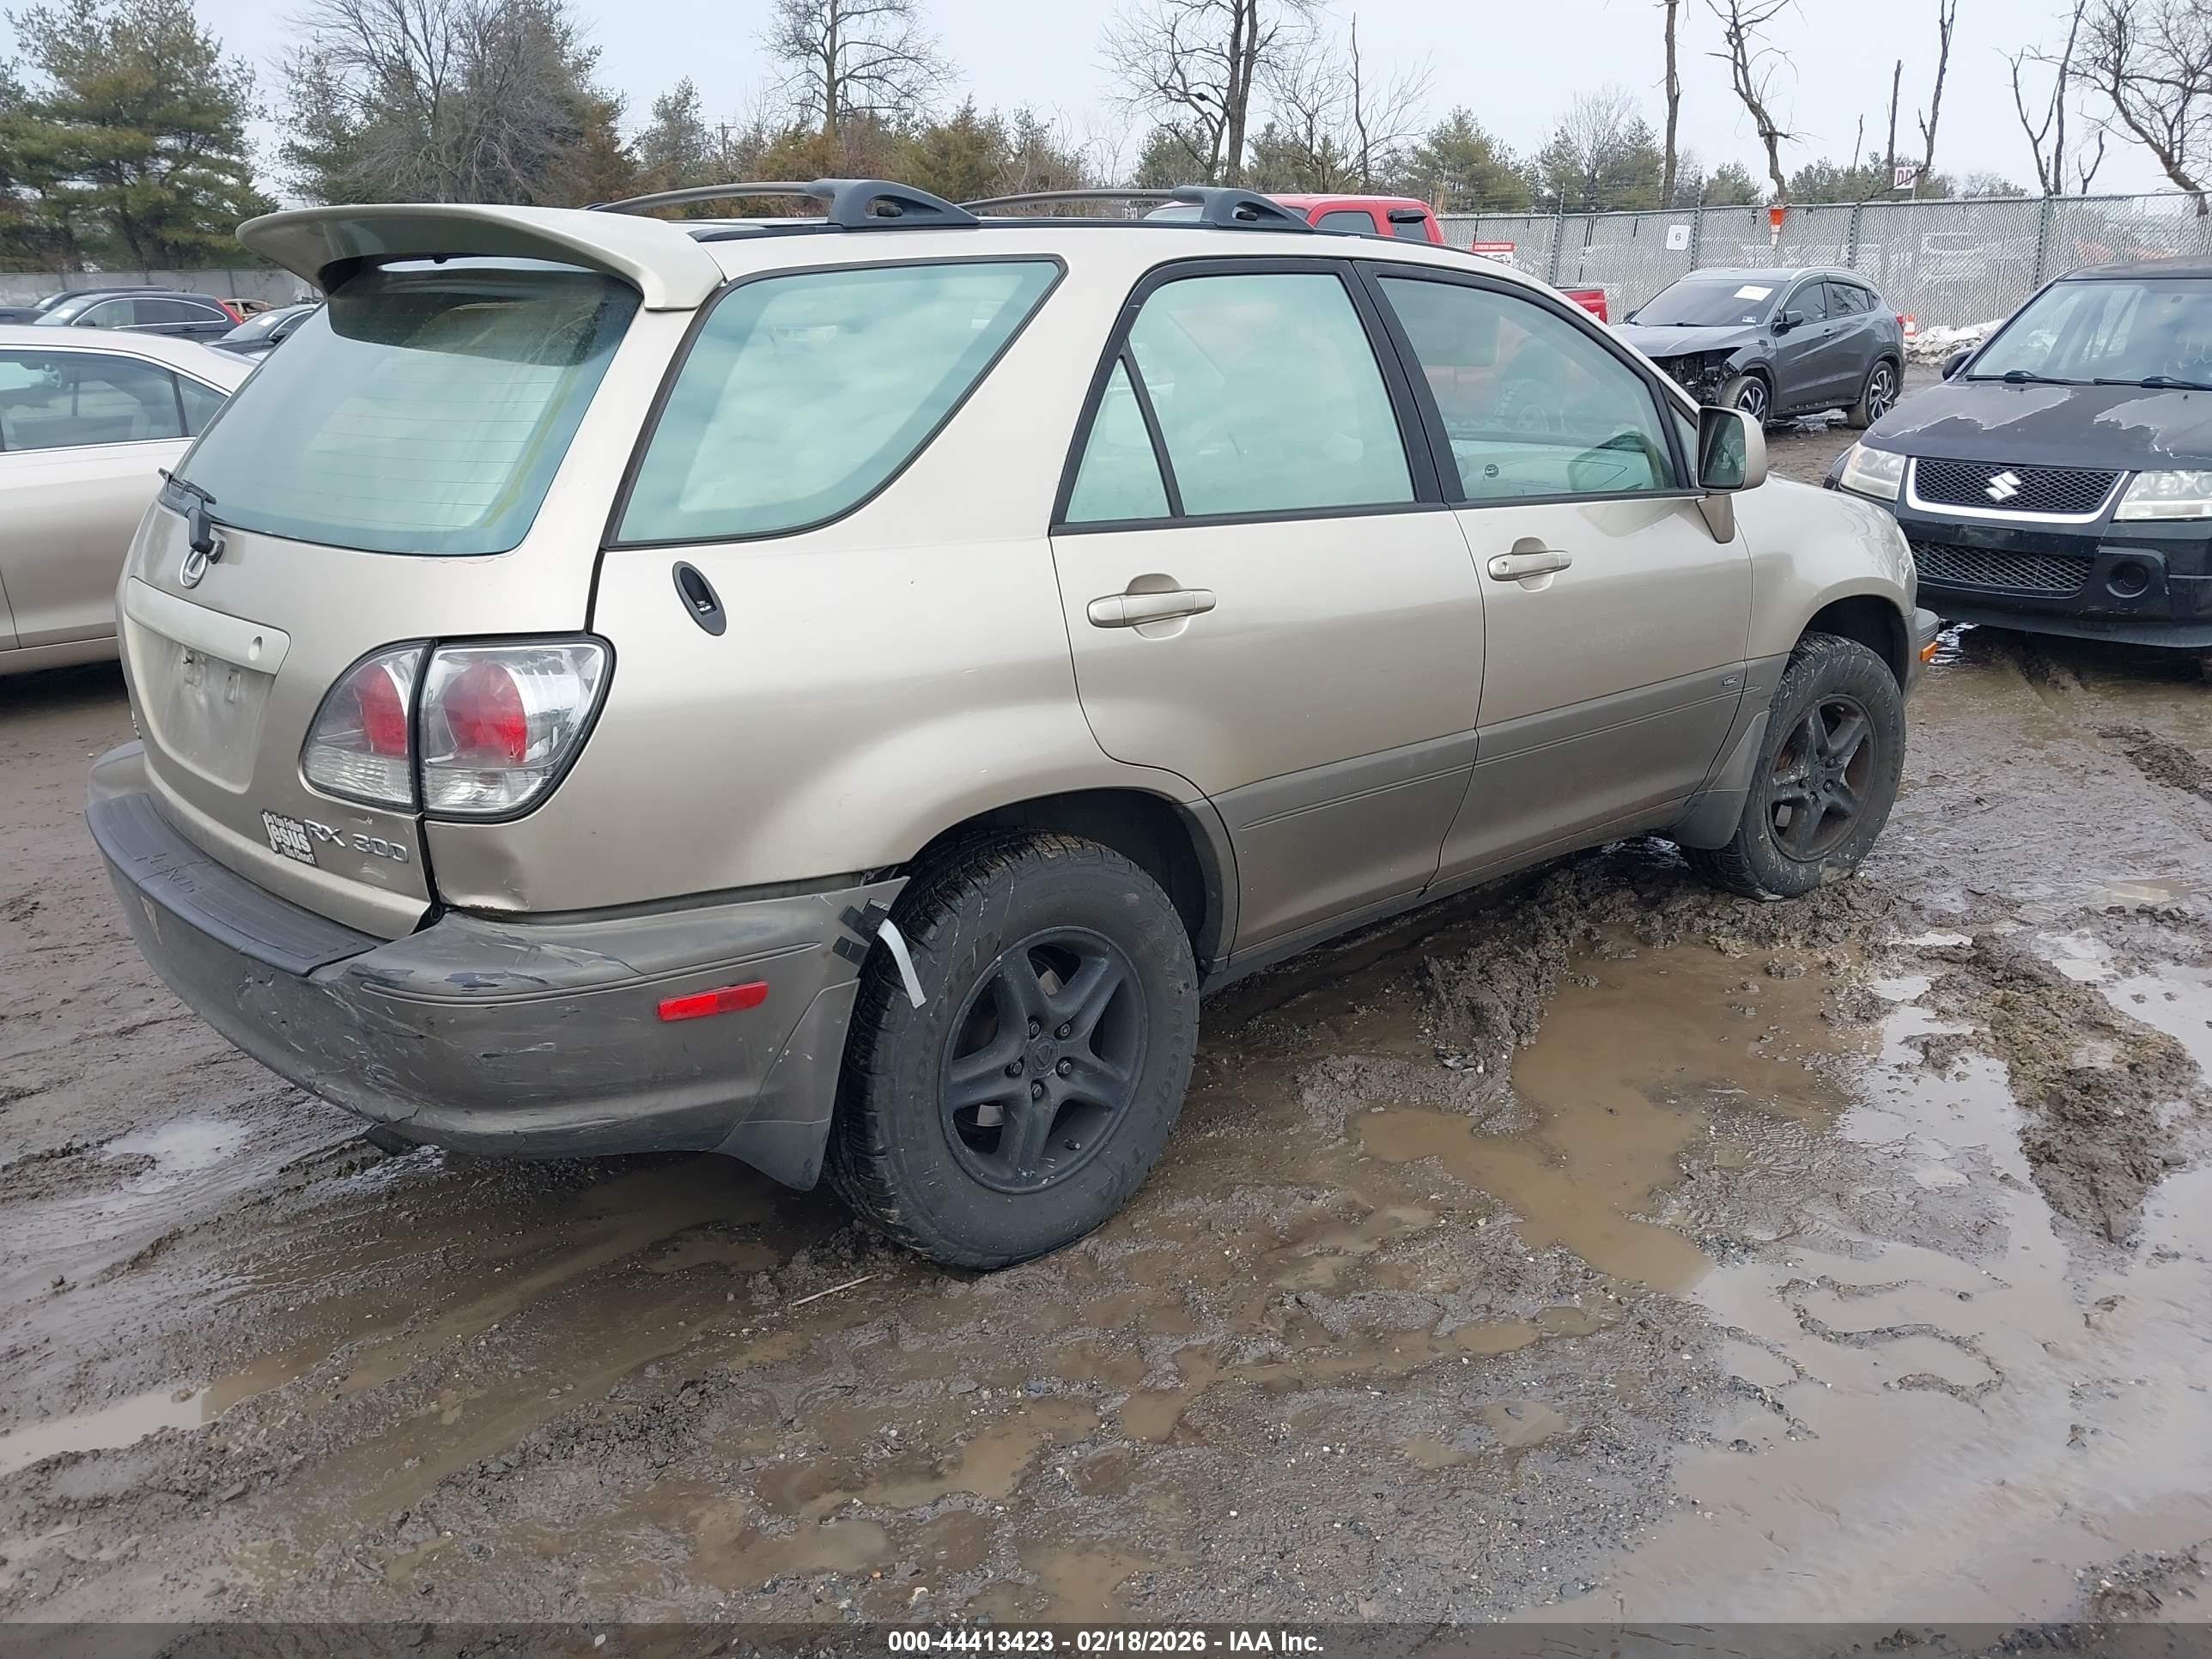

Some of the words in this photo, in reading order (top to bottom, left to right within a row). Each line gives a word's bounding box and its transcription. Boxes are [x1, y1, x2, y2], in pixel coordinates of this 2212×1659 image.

[1674, 232, 1682, 241] 6
[261, 813, 312, 853] Jesus
[304, 818, 347, 848] RX
[352, 833, 410, 863] 300
